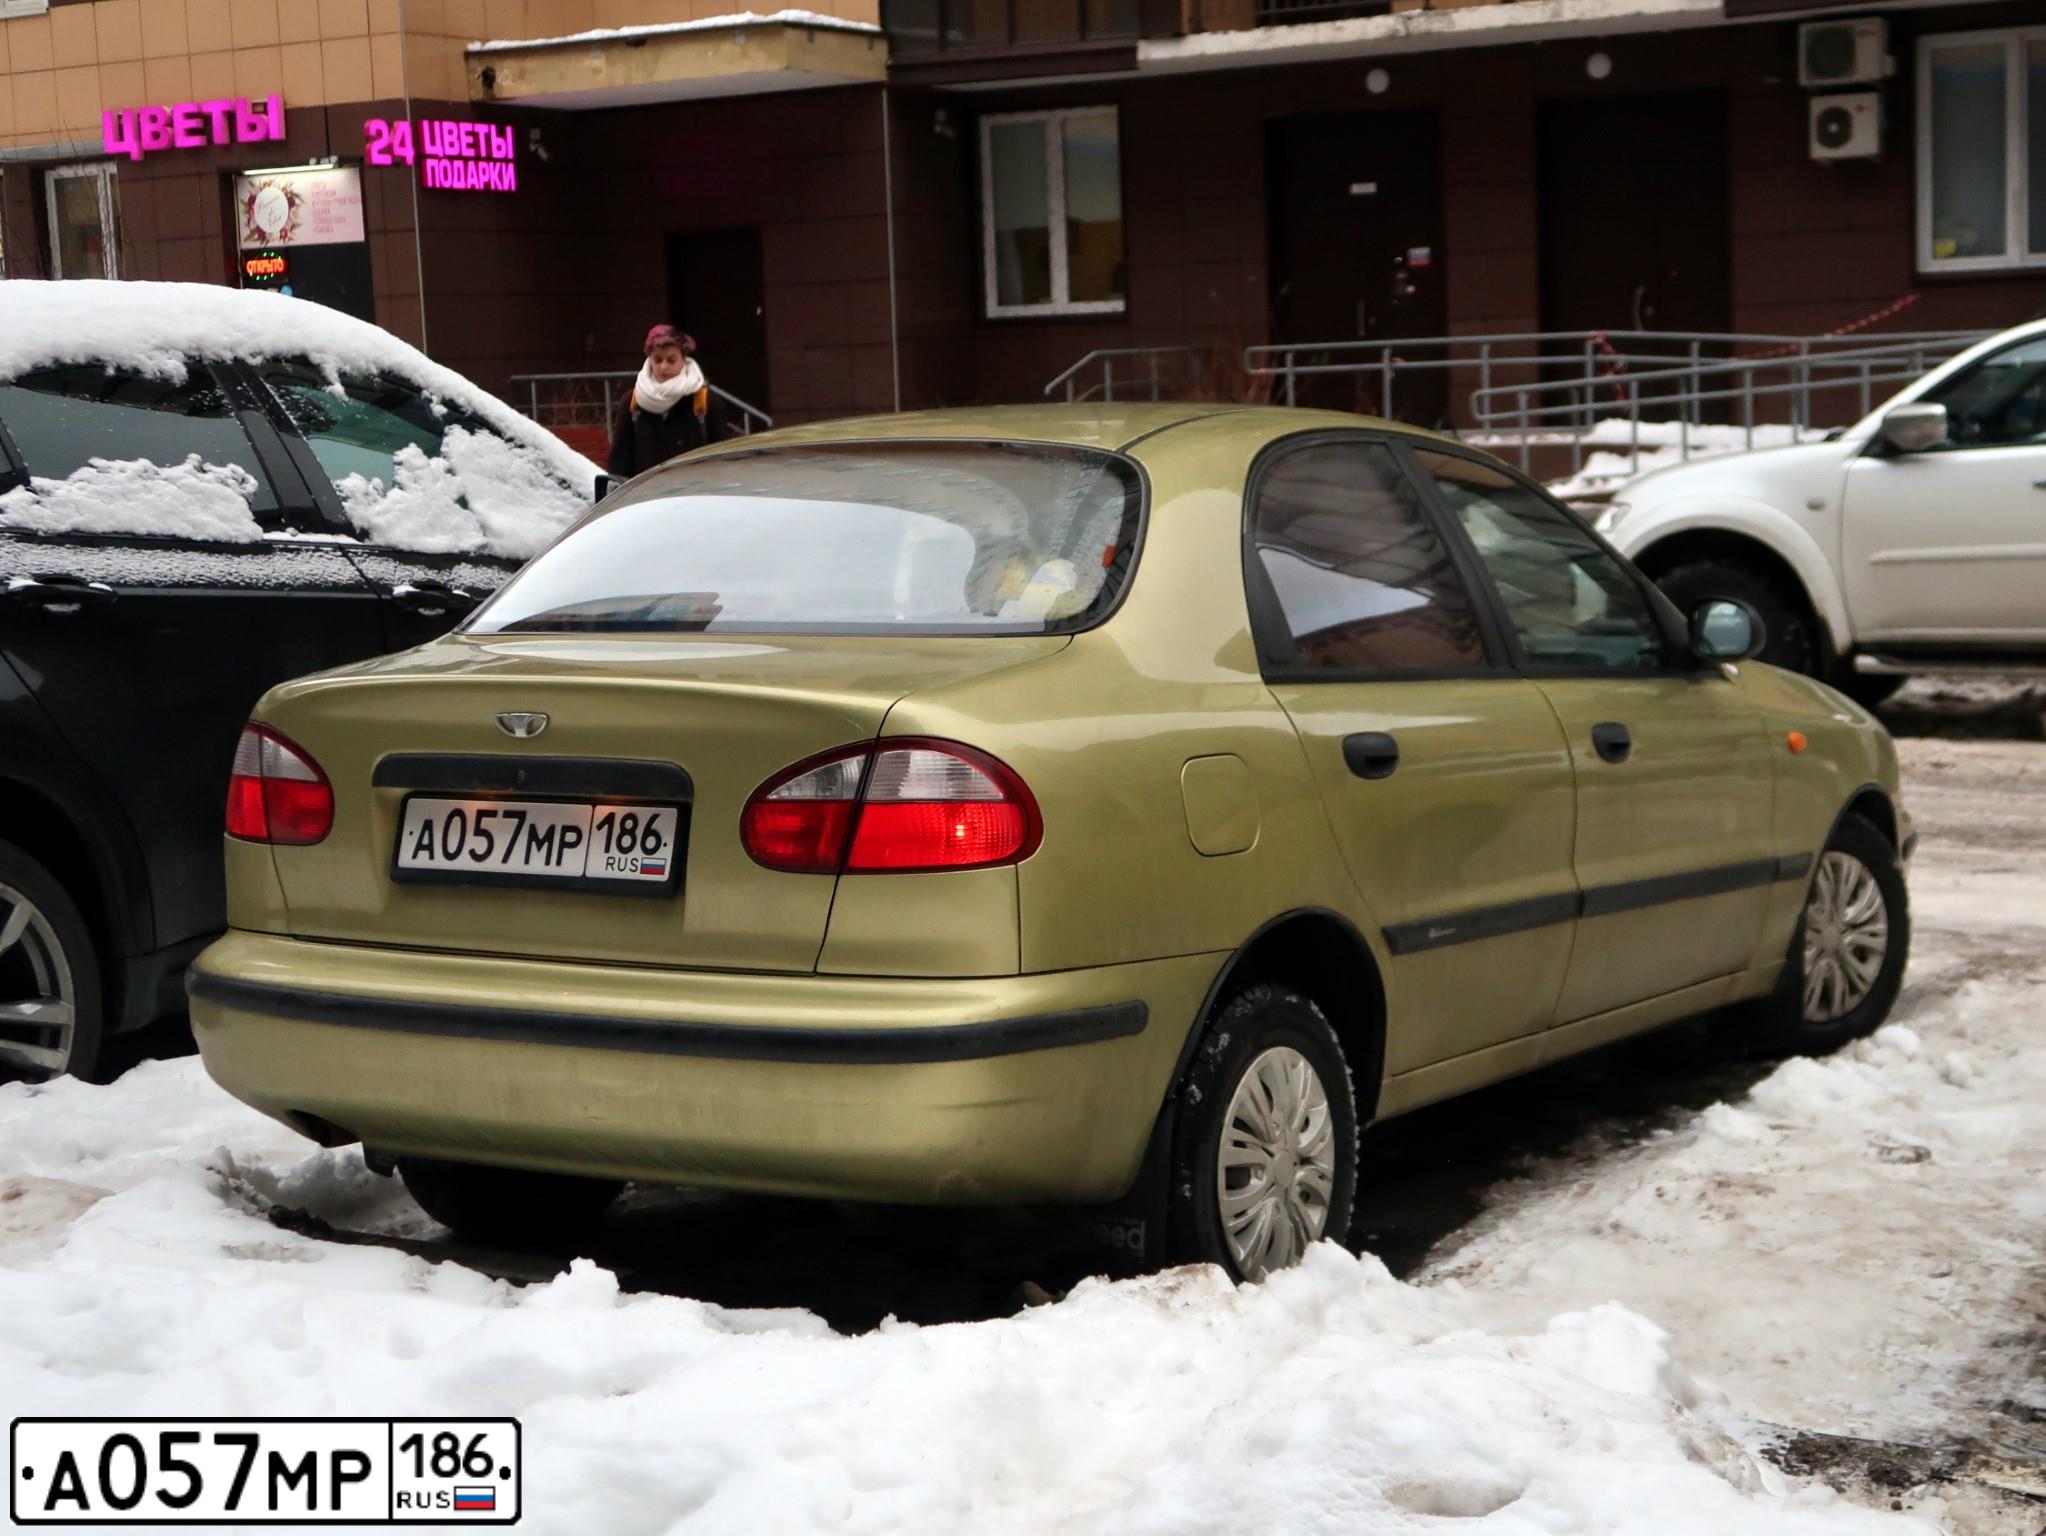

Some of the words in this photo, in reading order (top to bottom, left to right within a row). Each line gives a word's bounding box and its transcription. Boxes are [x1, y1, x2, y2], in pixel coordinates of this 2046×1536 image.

[102, 95, 286, 161] ЦВЕТЫ
[364, 118, 415, 166] 24
[420, 119, 515, 160] ЦВЕТЫ
[425, 158, 517, 192] ПОДАРКИ
[246, 258, 286, 274] ОТКРЫТО
[411, 808, 583, 867] А057МР
[596, 812, 663, 855] 186
[605, 856, 639, 873] RUS
